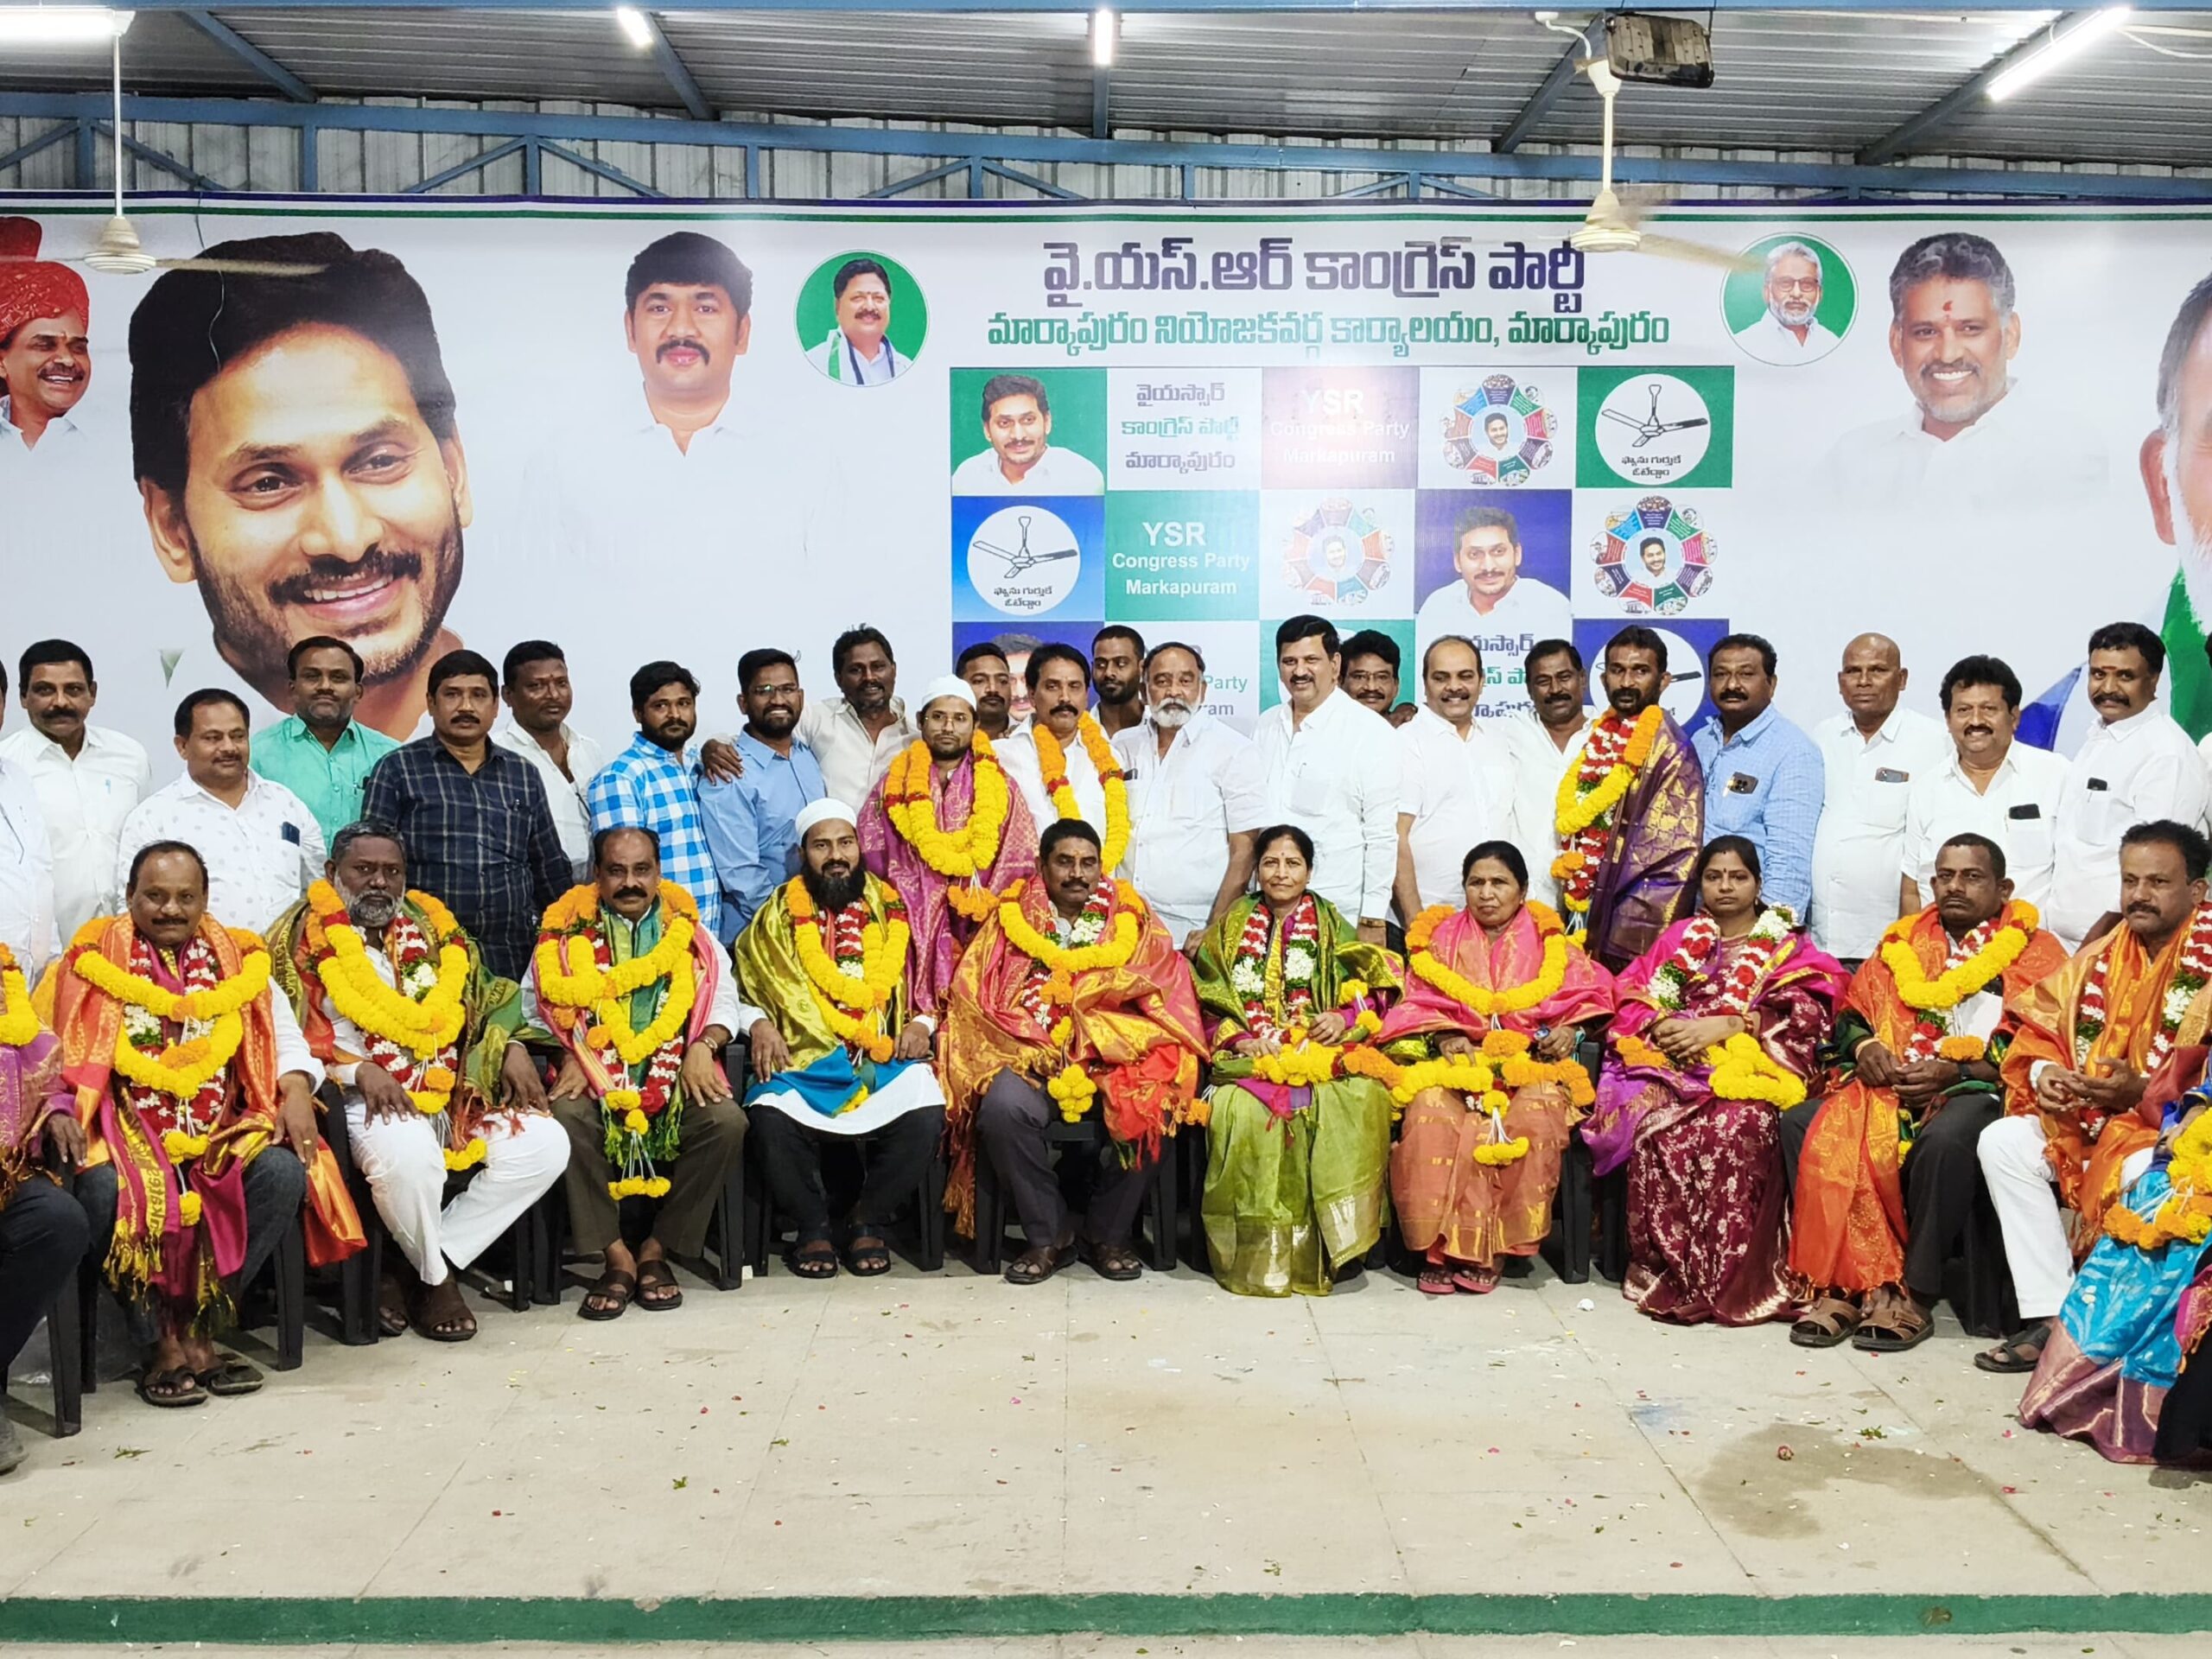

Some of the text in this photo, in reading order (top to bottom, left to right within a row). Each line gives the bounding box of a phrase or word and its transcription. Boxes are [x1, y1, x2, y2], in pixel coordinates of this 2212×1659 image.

[1043, 237, 1585, 313] వై.యస్.ఆర్ కాంగ్రెస్ పార్టీ
[988, 311, 1669, 359] మార్కాపురం నియోజకవర్గ కార్యాలయం, మార్కాపురం
[1136, 382, 1225, 407] వైయస్సార్
[1301, 389, 1364, 415] YSR
[1121, 416, 1193, 437] కాంగ్రెస్
[1270, 420, 1410, 439] Congress Party
[1125, 450, 1236, 474] మార్కాపురం
[1283, 448, 1395, 465] Markapuram
[1142, 522, 1207, 547] YSR
[1112, 553, 1250, 571] Congress Party
[1126, 579, 1237, 597] Markapuram
